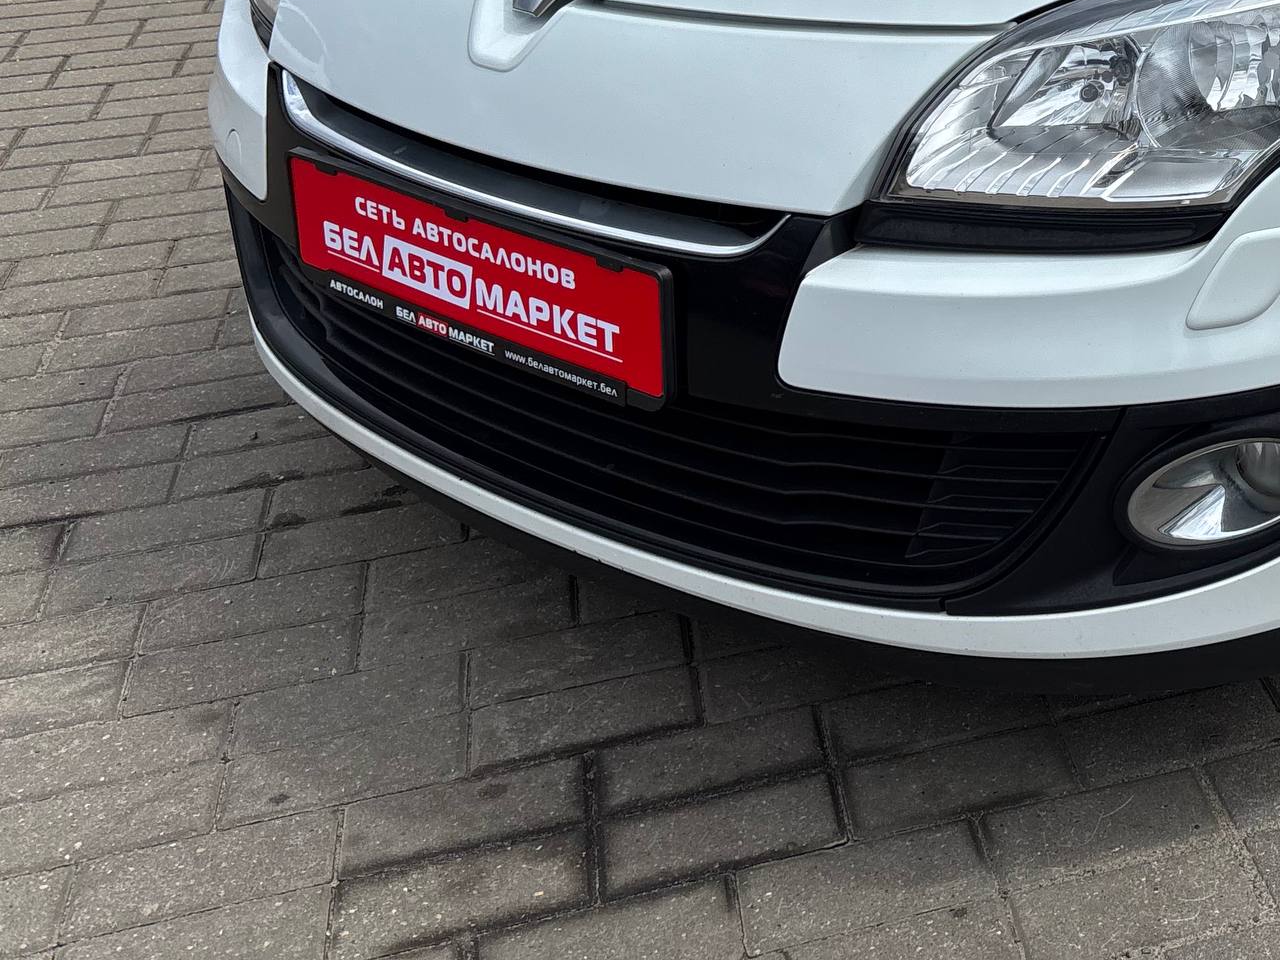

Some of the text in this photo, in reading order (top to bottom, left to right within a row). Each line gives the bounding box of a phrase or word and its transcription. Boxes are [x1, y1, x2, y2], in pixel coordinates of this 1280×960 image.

[323, 220, 620, 353] БЕЛ АВТО МАРКЕТ
[355, 197, 576, 289] СЕТЬ АВТОСАЛОНОВ
[330, 279, 618, 398] АВТОСАЛОН БЕЛ АВТО МАРКЕТ www.белавтомаркет.бел
